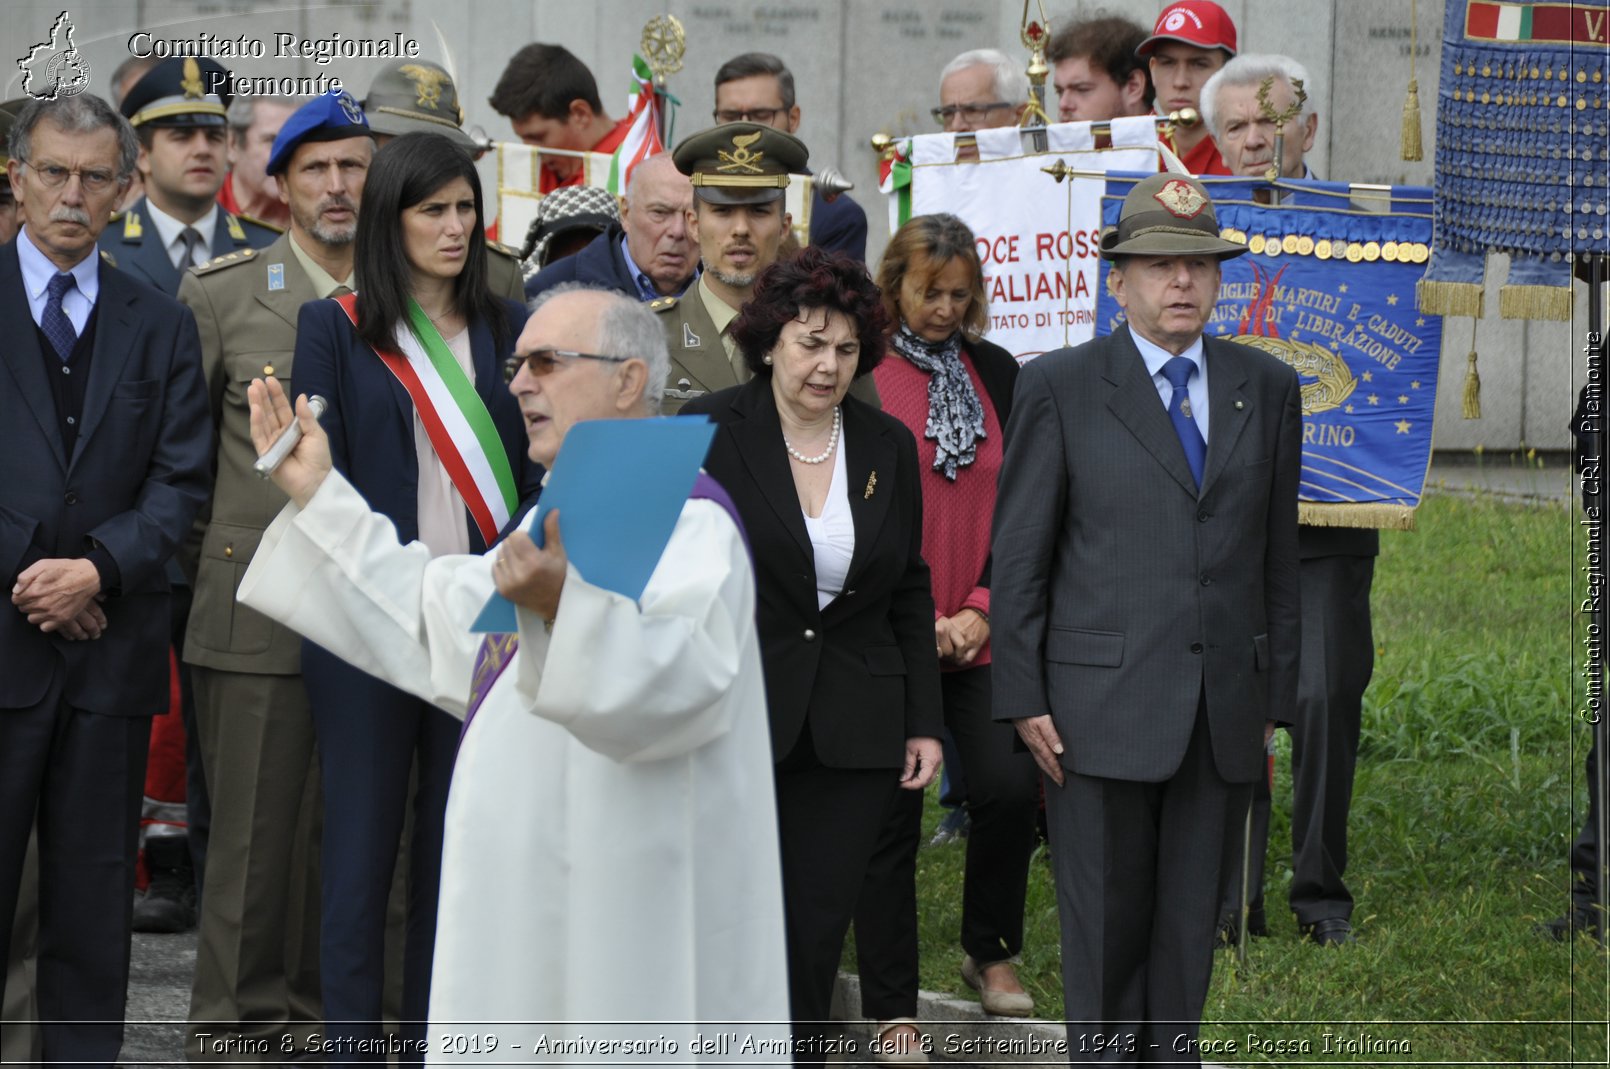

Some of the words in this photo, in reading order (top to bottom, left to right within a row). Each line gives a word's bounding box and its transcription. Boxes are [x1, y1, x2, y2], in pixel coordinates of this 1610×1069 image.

[1584, 10, 1604, 41] V.
[975, 235, 1019, 265] OCE
[1036, 229, 1098, 261] ROSS
[983, 270, 1089, 303] TALIANA
[988, 312, 1029, 330] ITATO
[1035, 312, 1050, 327] DI
[1057, 309, 1095, 326] TORIN
[1218, 282, 1261, 300] IGLIE
[1272, 285, 1341, 314] MARTIRI
[1347, 303, 1361, 321] E
[1368, 314, 1423, 354] CADUTI
[1208, 304, 1250, 322] AUSA
[1264, 305, 1284, 323] DI
[1295, 311, 1402, 371] LIBERAZIONE
[1302, 386, 1328, 409] UTI
[1302, 422, 1355, 447] RINO
